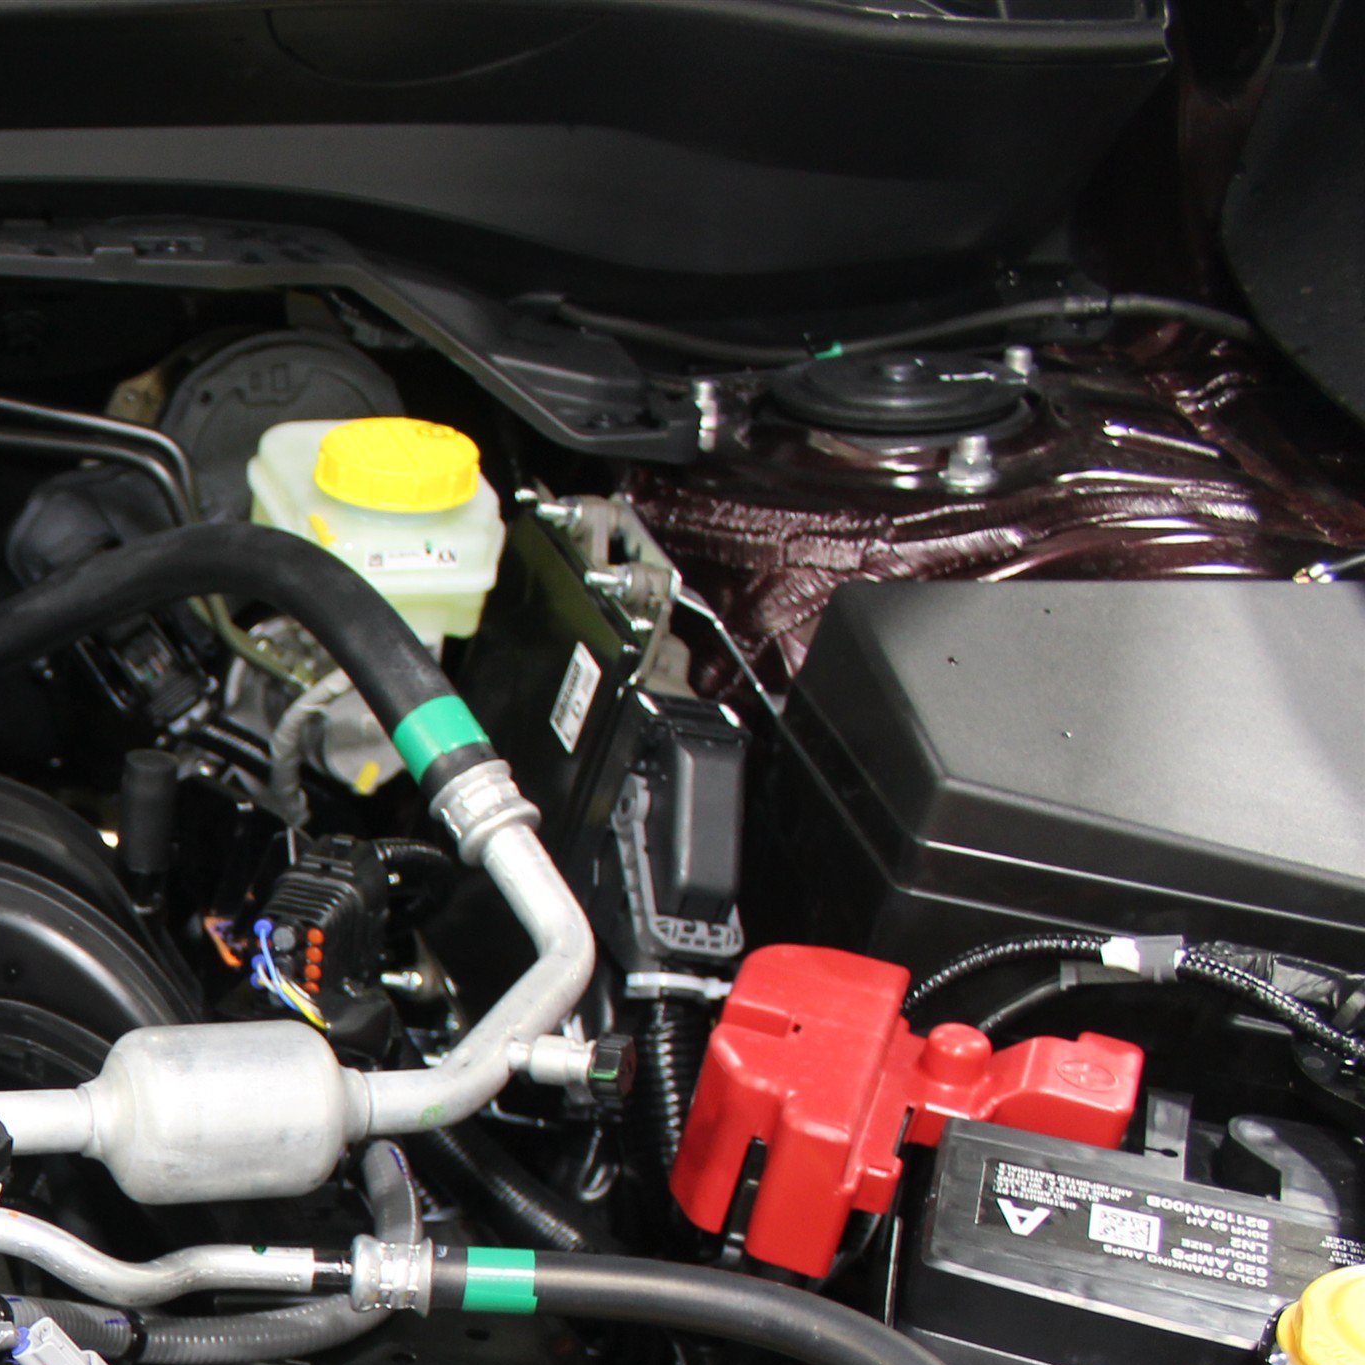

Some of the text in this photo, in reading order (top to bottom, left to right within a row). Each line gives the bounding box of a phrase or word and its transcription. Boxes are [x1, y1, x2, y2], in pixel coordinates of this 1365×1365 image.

[1181, 1237, 1268, 1265] GROUP SIZE
[1230, 1236, 1268, 1254] LN2
[1103, 1243, 1268, 1288] COLD CRANKING AMPS
[1171, 1247, 1229, 1269] AMPS
